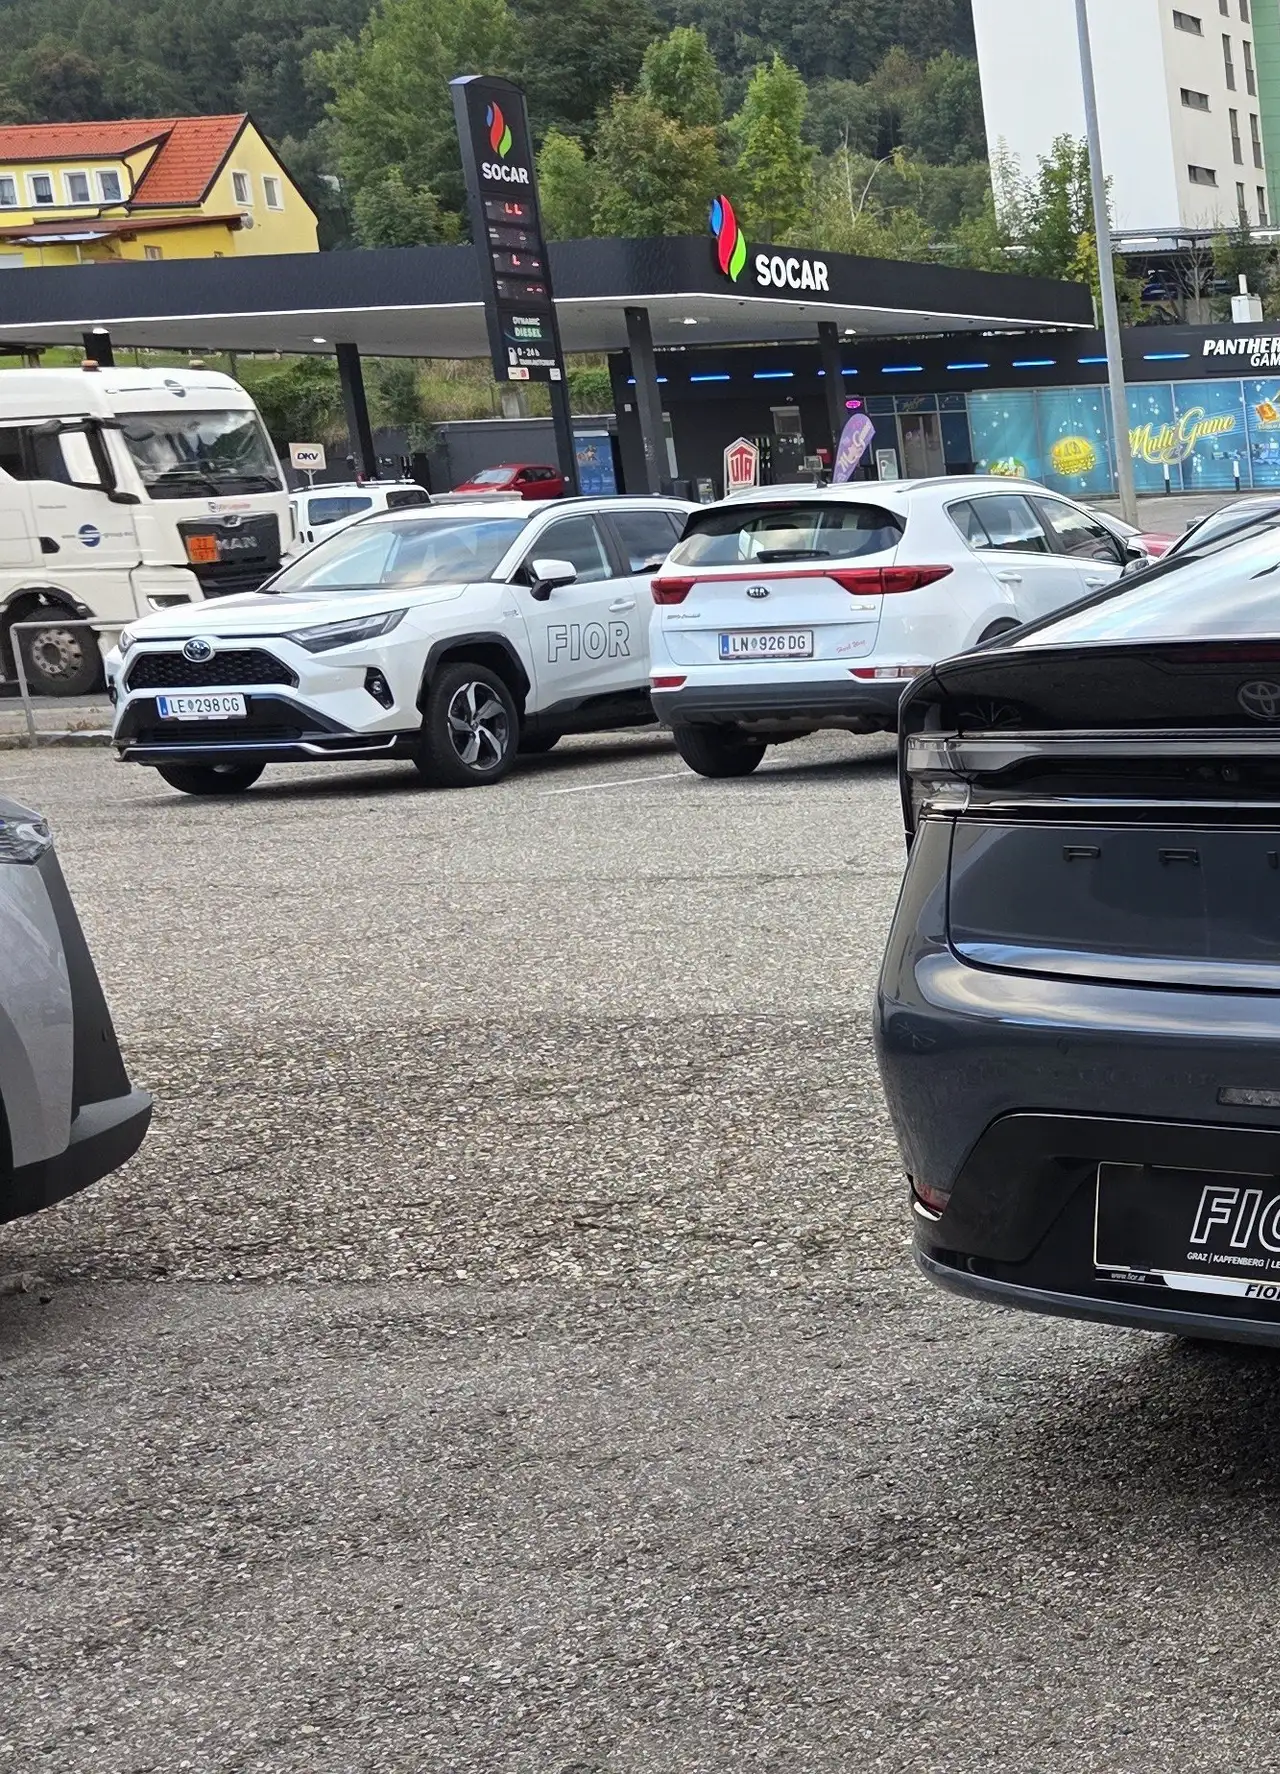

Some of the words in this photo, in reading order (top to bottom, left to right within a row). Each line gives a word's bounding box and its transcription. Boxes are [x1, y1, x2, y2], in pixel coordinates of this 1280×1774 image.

[481, 162, 530, 184] SOCAR
[755, 253, 830, 292] SOCAR
[514, 327, 542, 338] DIESEL
[1128, 421, 1177, 462] Multi
[1170, 405, 1236, 464] Game
[297, 452, 319, 461] DKV
[728, 446, 755, 485] UTA
[214, 536, 258, 550] MAN
[750, 588, 766, 596] KIA
[547, 620, 630, 663] FIOR
[732, 637, 749, 652] LN
[759, 636, 786, 650] 926
[788, 635, 806, 650] DG
[169, 699, 187, 714] LE
[194, 698, 221, 713] 298
[222, 697, 240, 712] CG
[1186, 1252, 1209, 1262] GRAZ
[1212, 1254, 1265, 1268] KAPFENBERG
[1110, 1272, 1146, 1282] www.fior.at
